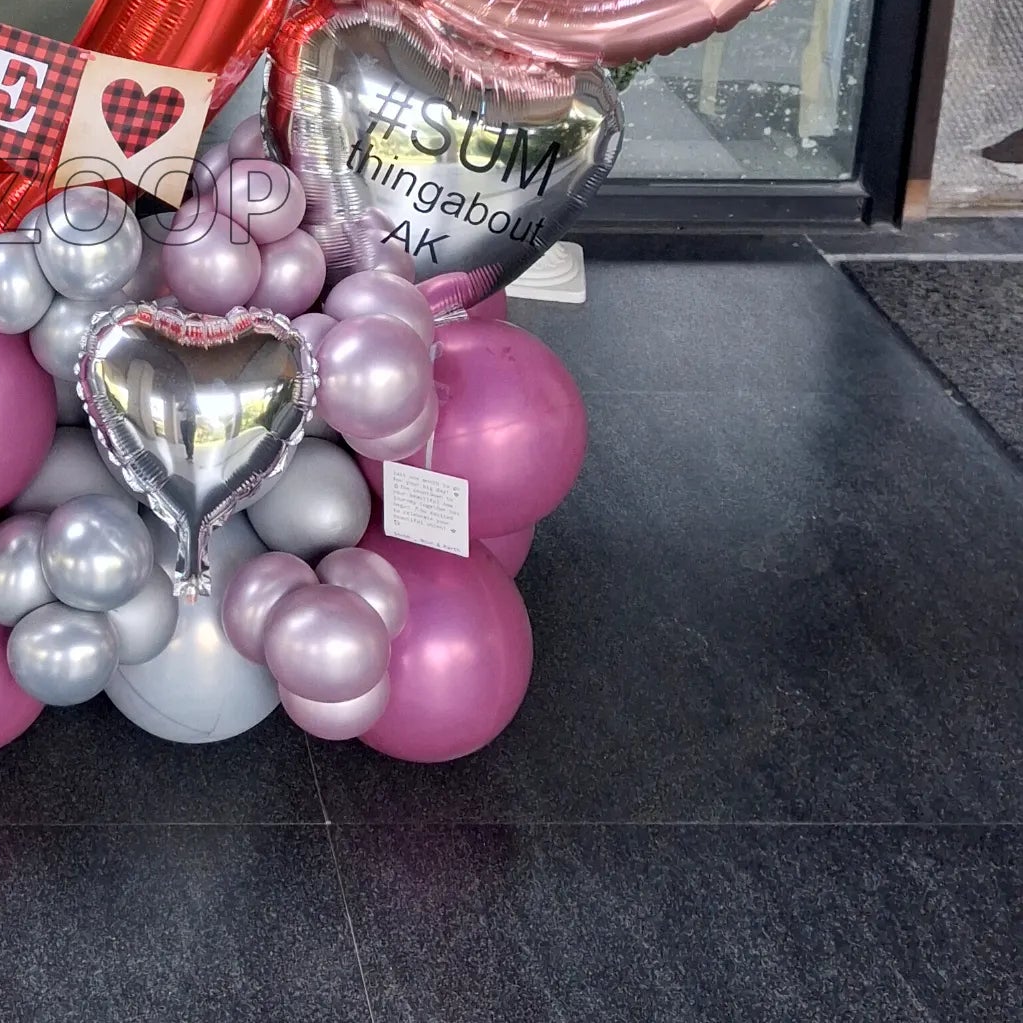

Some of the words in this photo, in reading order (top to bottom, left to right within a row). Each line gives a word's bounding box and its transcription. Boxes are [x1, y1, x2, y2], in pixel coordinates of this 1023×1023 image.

[366, 81, 561, 197] #SUM
[346, 140, 546, 246] thingabout
[380, 219, 450, 264] AK
